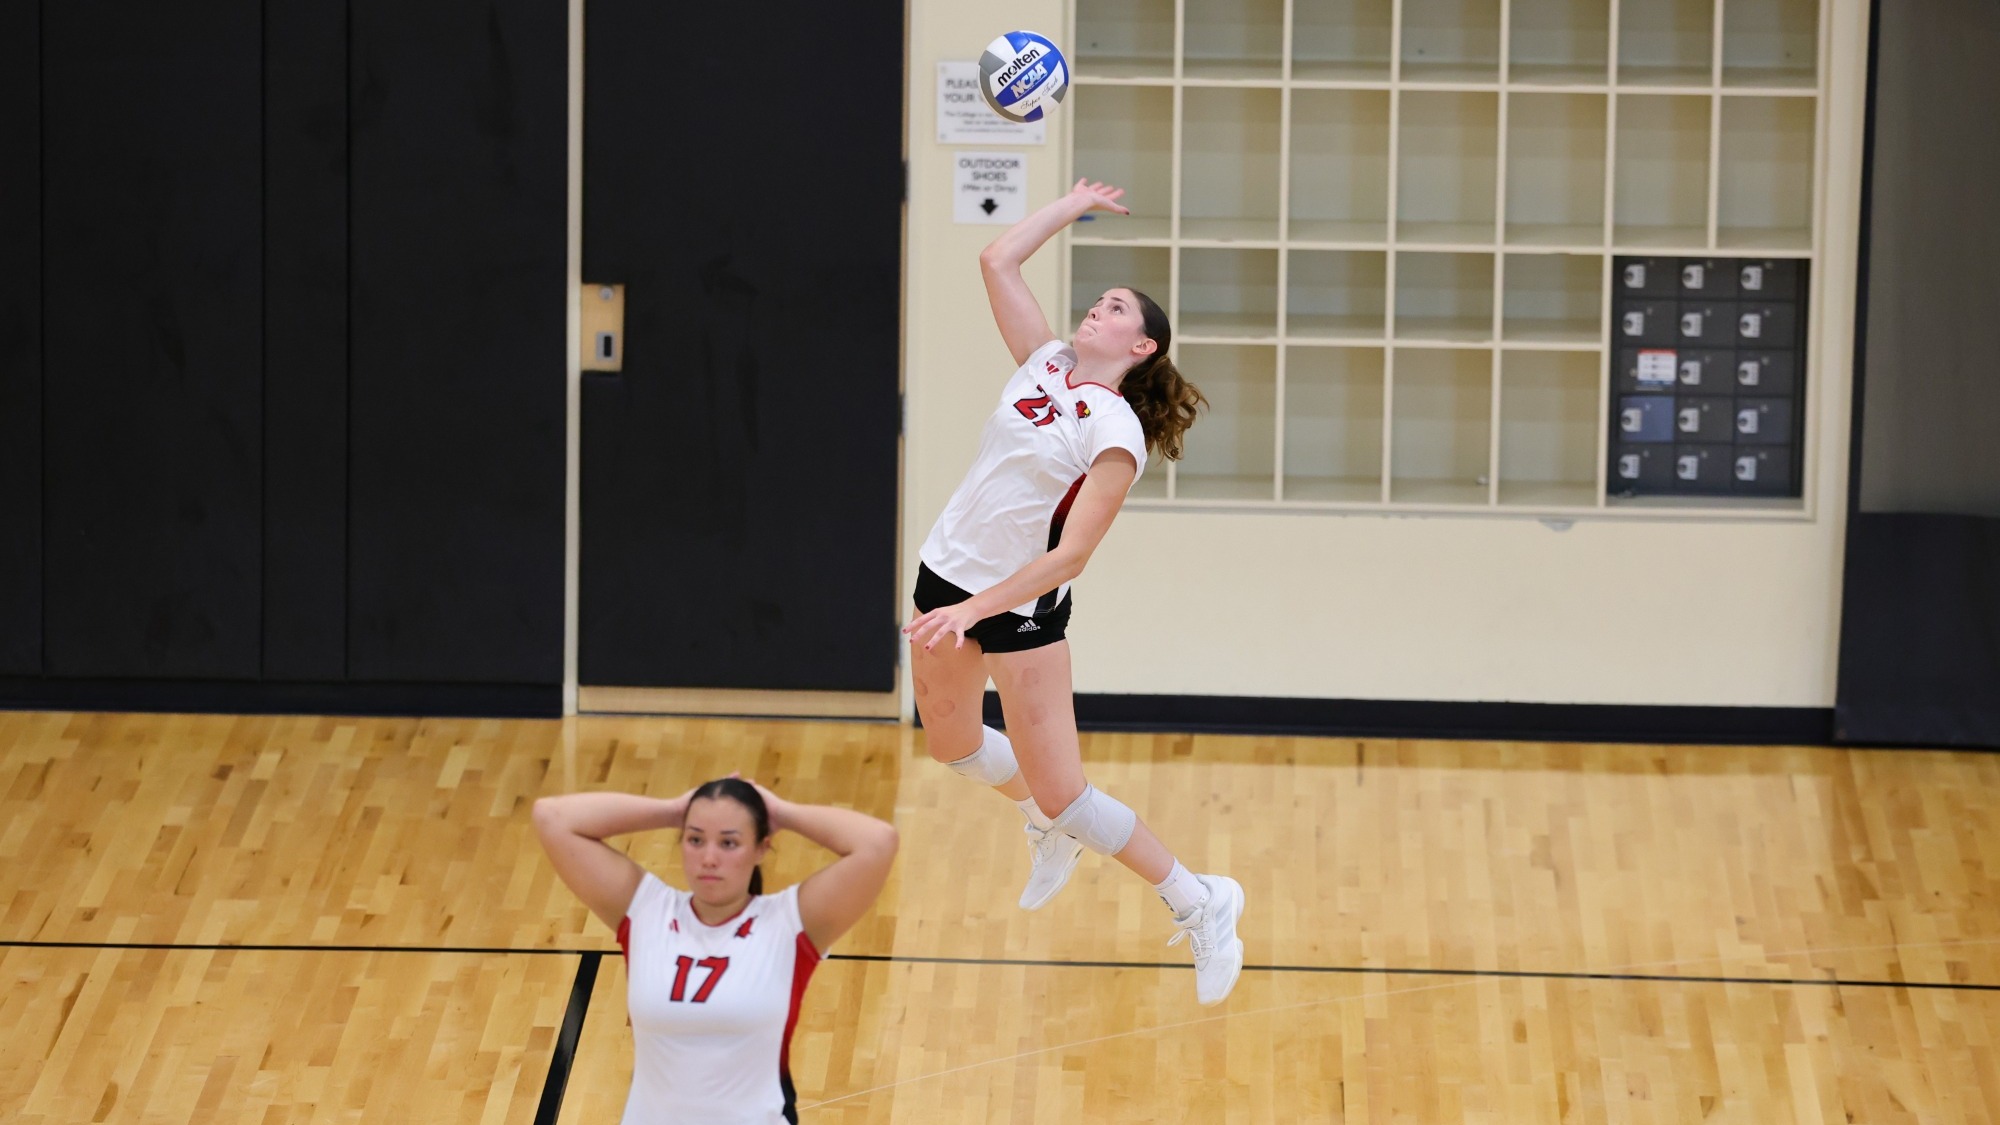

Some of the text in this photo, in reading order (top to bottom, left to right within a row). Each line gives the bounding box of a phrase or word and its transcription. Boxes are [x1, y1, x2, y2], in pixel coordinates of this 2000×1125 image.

[998, 49, 1040, 87] molten
[946, 79, 979, 89] PLEAS
[1010, 62, 1048, 99] NCAA
[944, 93, 975, 103] YOUR
[959, 158, 1020, 169] OUTDOOR
[972, 171, 1008, 182] SHOES
[669, 954, 731, 1004] 17
